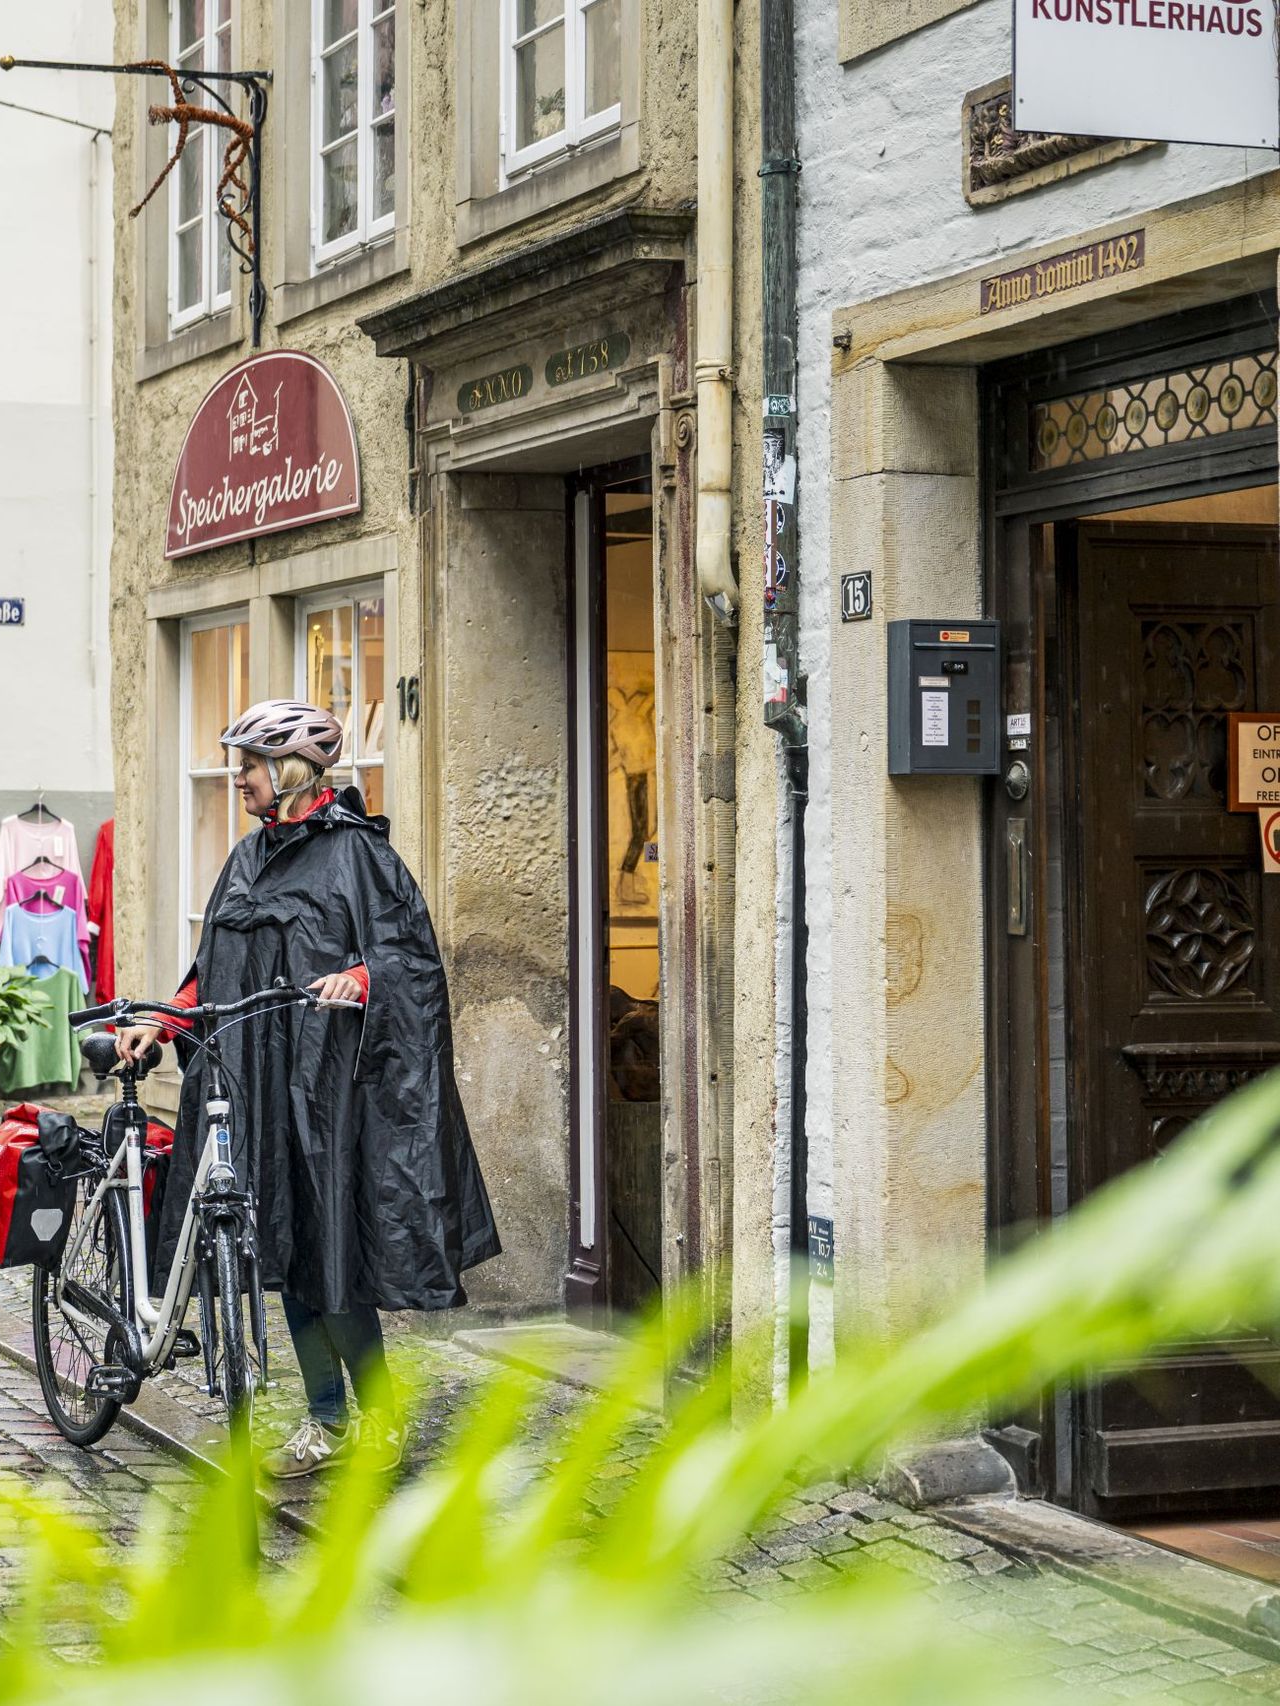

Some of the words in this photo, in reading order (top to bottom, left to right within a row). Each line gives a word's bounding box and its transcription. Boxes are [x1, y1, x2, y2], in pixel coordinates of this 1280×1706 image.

[981, 277, 1033, 314] Anno
[1036, 249, 1094, 298] domini
[176, 452, 343, 545] Speichergalerie
[846, 579, 865, 614] 15
[396, 676, 420, 721] 16
